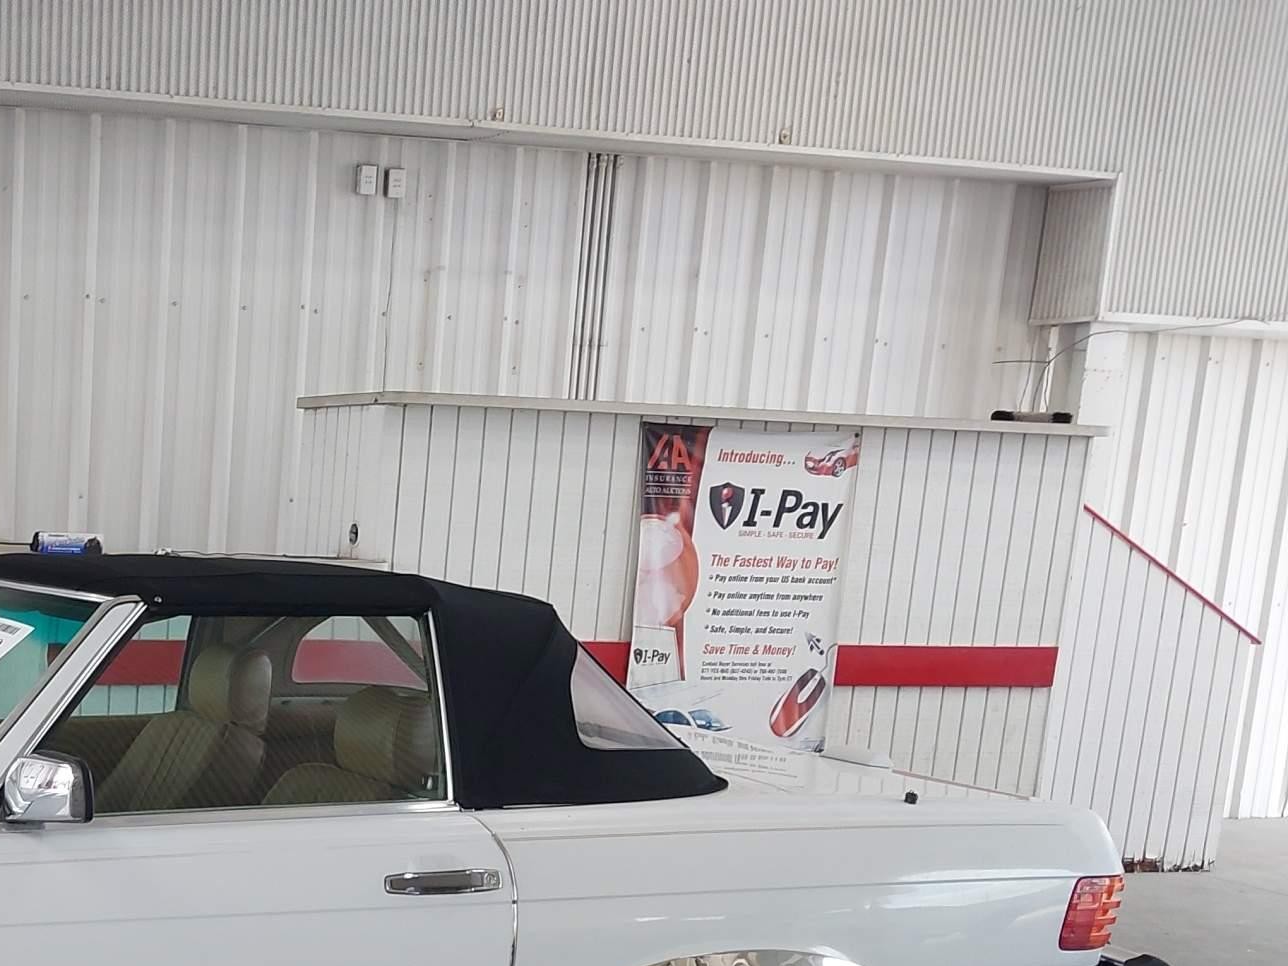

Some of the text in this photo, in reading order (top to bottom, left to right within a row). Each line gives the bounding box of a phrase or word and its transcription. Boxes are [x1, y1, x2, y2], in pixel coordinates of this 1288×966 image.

[718, 448, 796, 467] Introducing...
[646, 474, 692, 483] INSURANCE
[742, 488, 844, 539] I-Pay
[738, 530, 762, 538] SIMPLE
[711, 554, 839, 572] The Fastest Way to Pay!
[715, 574, 727, 584] Pay
[728, 574, 748, 583] online
[750, 575, 765, 583] from
[765, 576, 780, 585] your
[781, 575, 790, 583] US
[791, 576, 806, 584] bank
[713, 591, 824, 602] Pay online anytime from anywhere
[711, 608, 810, 619] No additional fees to use I-Pay
[710, 625, 794, 635] Safe, Simple, and Secure!
[702, 644, 797, 658] Save Time & Money!
[642, 649, 671, 665] I-Pay
